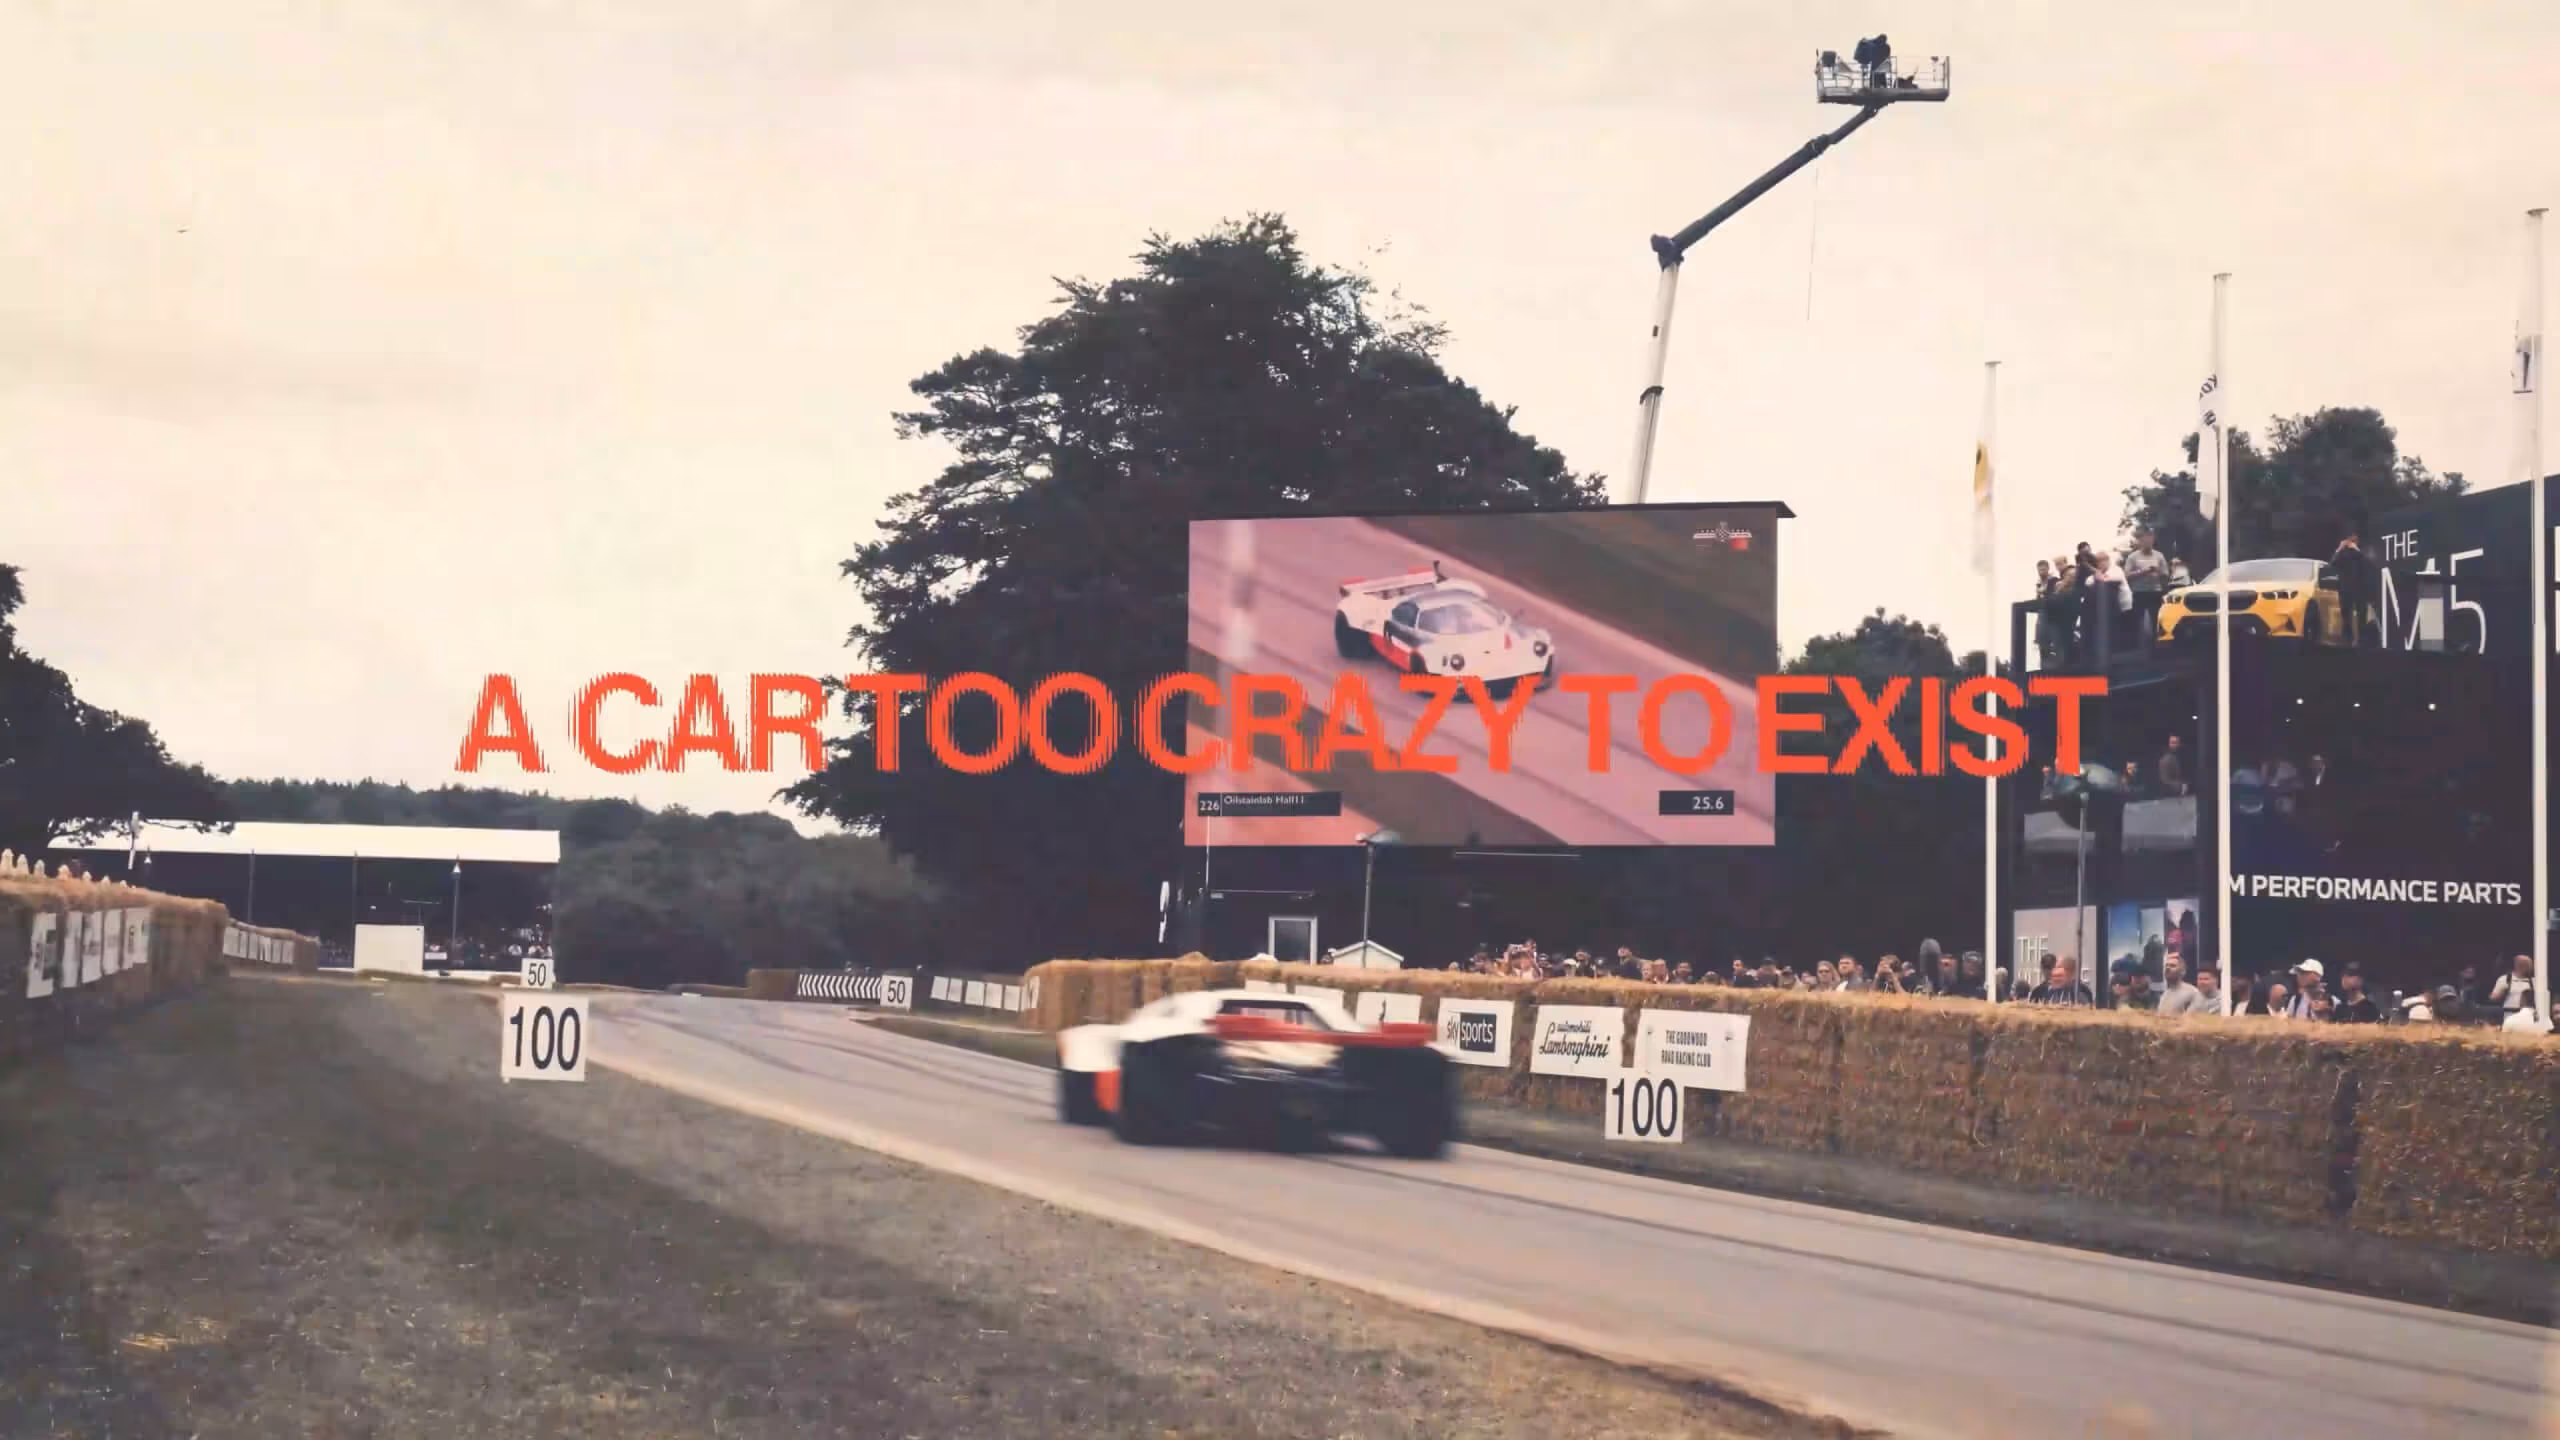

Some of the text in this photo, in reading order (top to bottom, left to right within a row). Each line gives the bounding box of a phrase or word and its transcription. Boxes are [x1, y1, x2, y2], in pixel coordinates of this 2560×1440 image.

[2381, 529, 2419, 561] THE
[1199, 800, 1220, 811] 226
[1692, 796, 1724, 810] 25.6
[2229, 873, 2522, 905] M PERFORMANCE PARTS
[527, 962, 547, 986] 50
[887, 979, 906, 1004] 50
[510, 1005, 581, 1071] 100
[1447, 1015, 1494, 1047] sky sports
[1539, 1021, 1611, 1064] Lamborghini
[1612, 1077, 1678, 1137] 100
